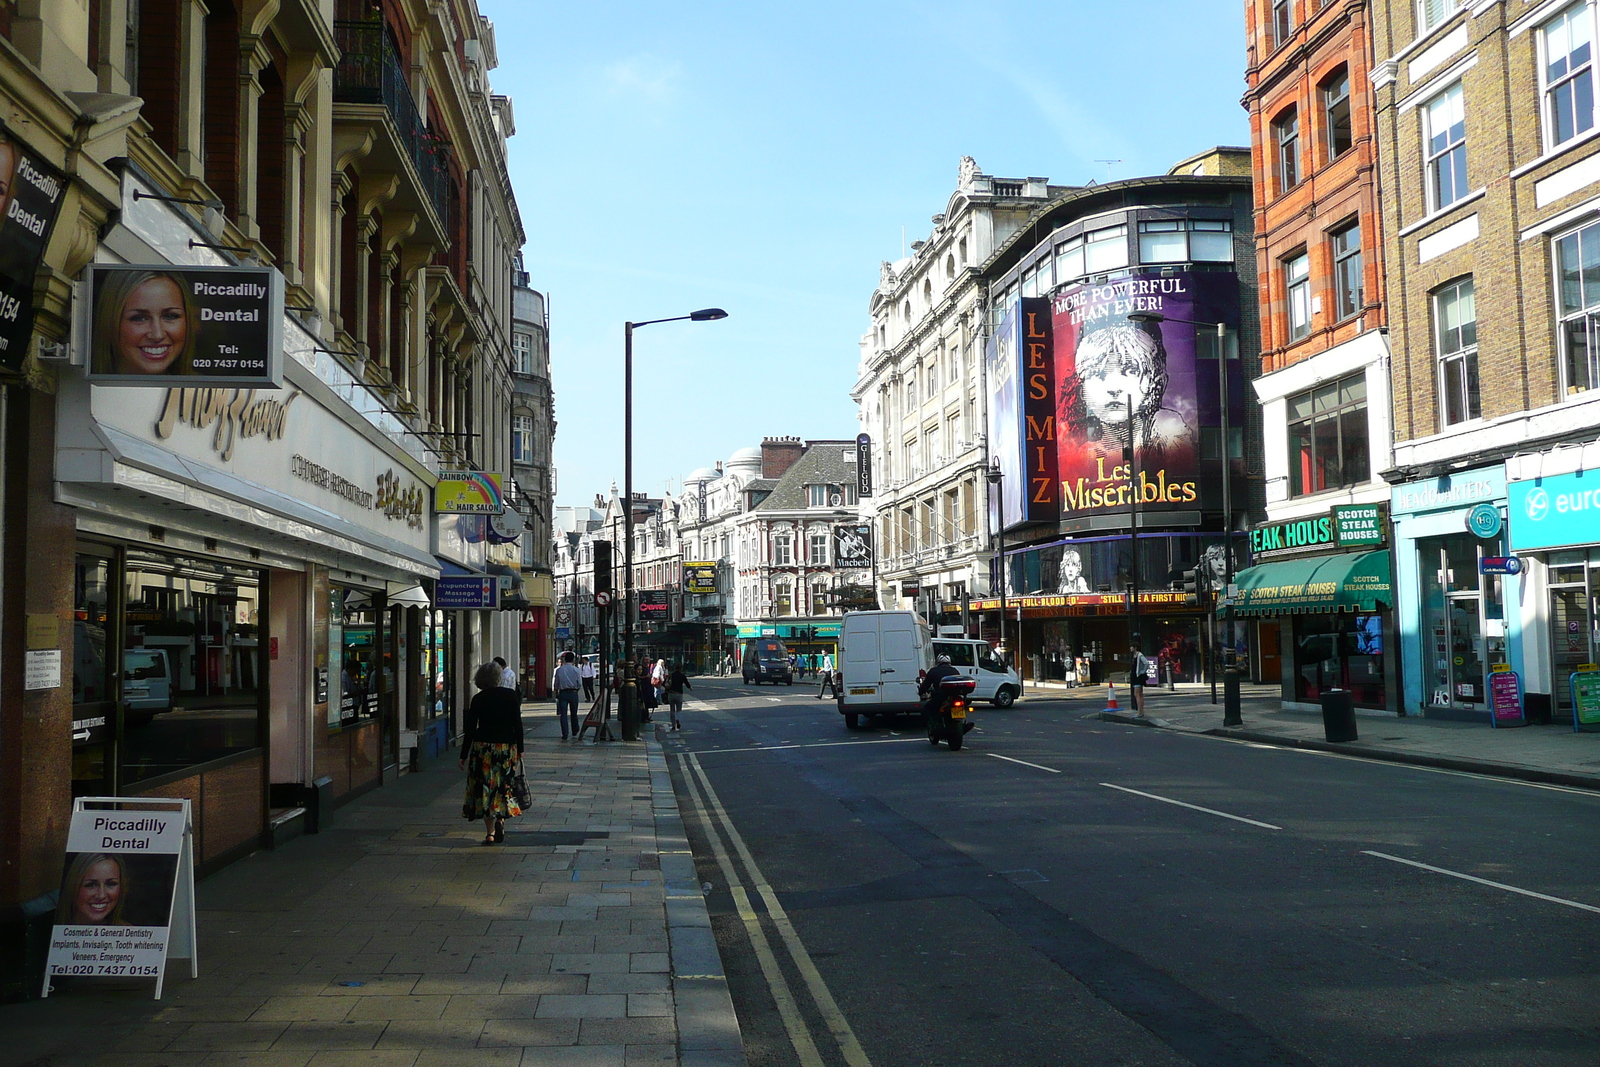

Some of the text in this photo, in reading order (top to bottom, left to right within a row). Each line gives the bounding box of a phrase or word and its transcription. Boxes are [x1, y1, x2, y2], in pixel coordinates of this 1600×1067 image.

[17, 156, 61, 204] Piccadilly
[7, 199, 47, 237] Dental
[194, 282, 266, 299] Piccadilly
[1055, 278, 1186, 315] MORE POWERFUL
[200, 307, 259, 322] Dental
[1069, 295, 1163, 325] THAN EVER!
[218, 344, 239, 354] Tel:
[193, 358, 264, 368] 020 7437 0154
[1026, 312, 1054, 503] LES MIZ
[860, 444, 869, 493] GIELGUD
[1096, 457, 1131, 482] Les
[292, 454, 330, 490] CHINESE
[330, 472, 373, 511] RESTAURANT
[439, 473, 473, 481] RAINBOW
[1062, 470, 1197, 513] Misérables
[456, 503, 499, 511] HAIR SALON
[1337, 509, 1377, 519] SCOTCH
[1341, 519, 1375, 530] STEAK
[1286, 518, 1334, 547] HOUS
[1340, 529, 1379, 541] HOUSES
[1151, 593, 1172, 602] FIRST
[1250, 586, 1279, 599] SCOTCH
[1279, 584, 1303, 597] STEAK
[1305, 581, 1337, 595] HOUSES
[94, 817, 167, 835] Piccadilly
[101, 836, 150, 849] Dental
[63, 928, 154, 939] Cosmetic & General Dentistry
[52, 940, 81, 949] Implants,
[115, 940, 133, 949] Tooth
[133, 941, 164, 951] whitening
[72, 952, 135, 963] Veneers, Emergency
[51, 965, 159, 975] Tel:020 7437 0154
